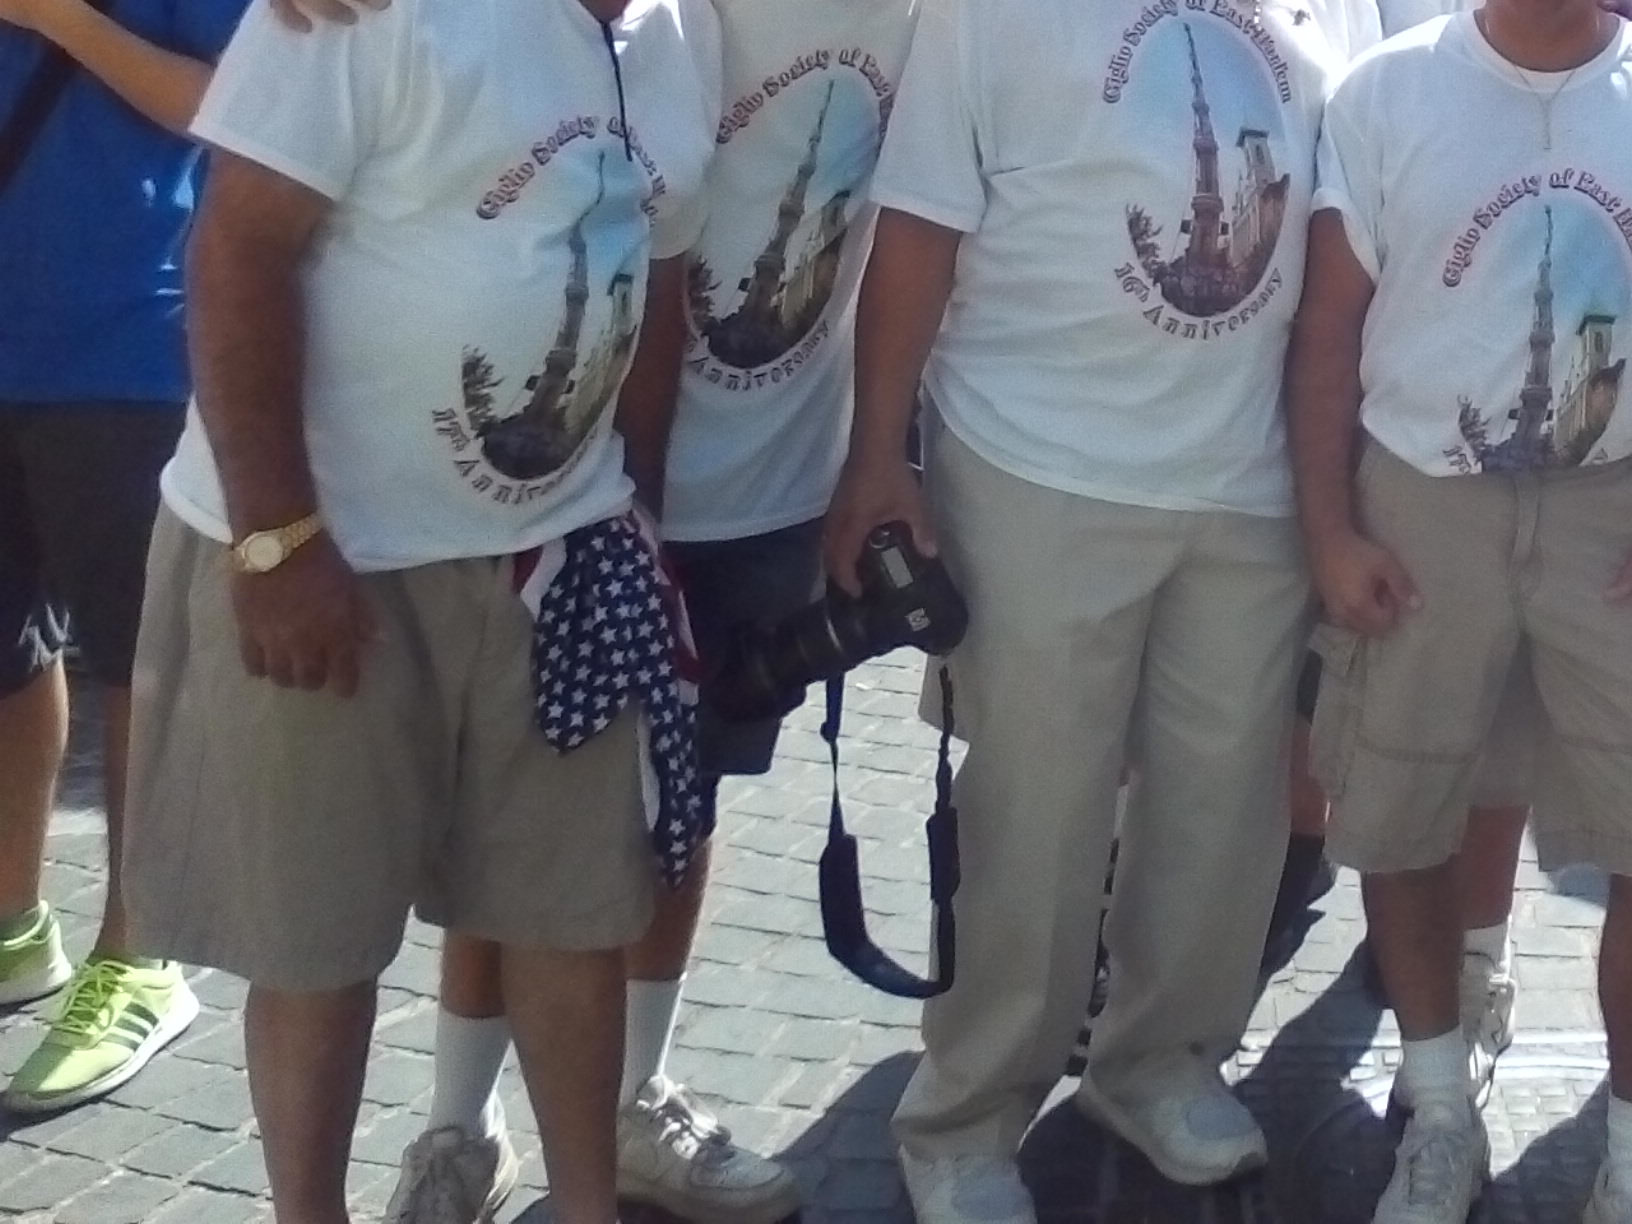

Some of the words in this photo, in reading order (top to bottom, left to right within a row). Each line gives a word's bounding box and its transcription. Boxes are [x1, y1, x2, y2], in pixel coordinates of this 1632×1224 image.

[763, 49, 831, 97] Society
[838, 47, 860, 67] of
[1102, 42, 1132, 104] Giglio
[476, 161, 536, 220] Giglio
[532, 115, 600, 166] Society
[1442, 228, 1481, 288] Giglio
[1473, 174, 1542, 230] Society
[1549, 168, 1575, 189] of
[1574, 171, 1622, 214] East
[1142, 267, 1284, 341] Anniversary
